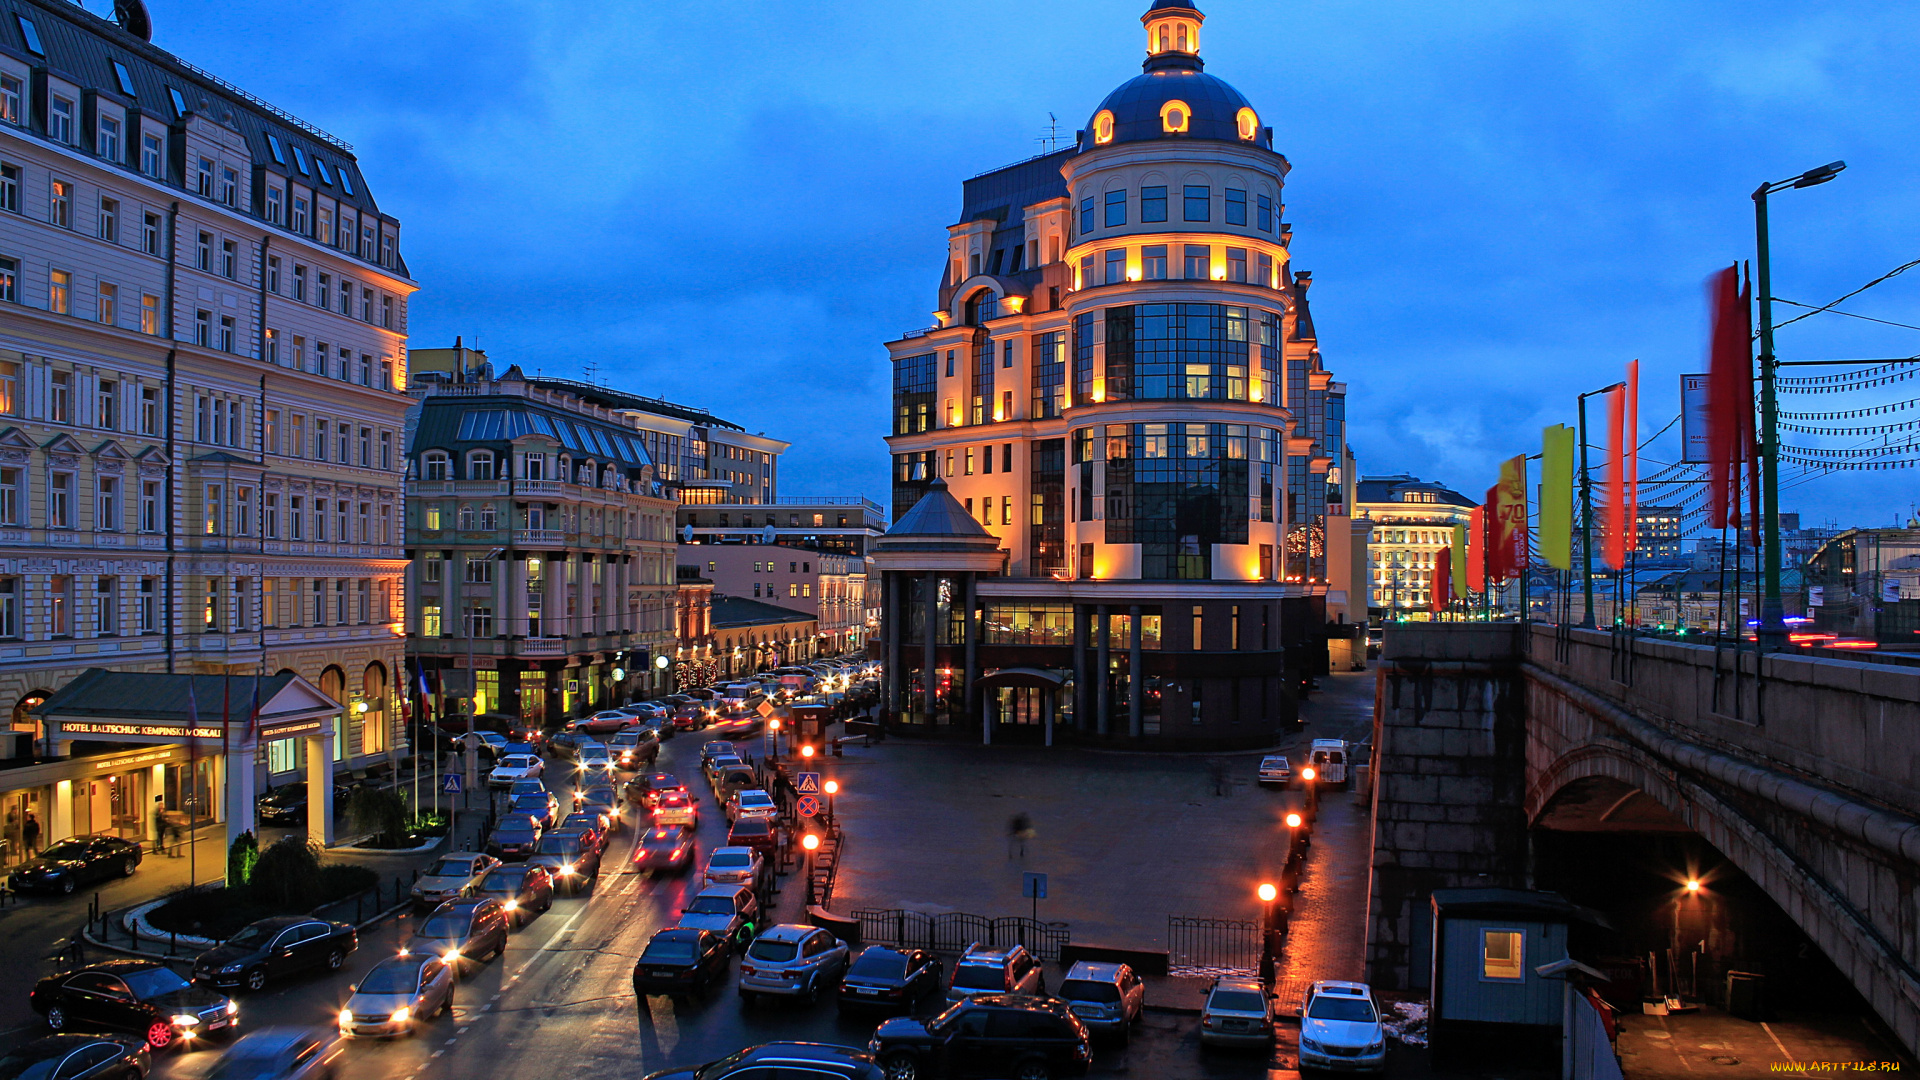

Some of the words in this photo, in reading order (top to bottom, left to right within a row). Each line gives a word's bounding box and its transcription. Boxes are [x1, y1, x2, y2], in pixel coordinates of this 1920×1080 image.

[1501, 504, 1525, 521] 70
[62, 723, 90, 733] HOTEL
[91, 724, 141, 735] BALTSCHUG
[141, 726, 184, 736] KEMPINSKI
[185, 728, 221, 738] MOSKAU
[1698, 939, 1706, 954] 1
